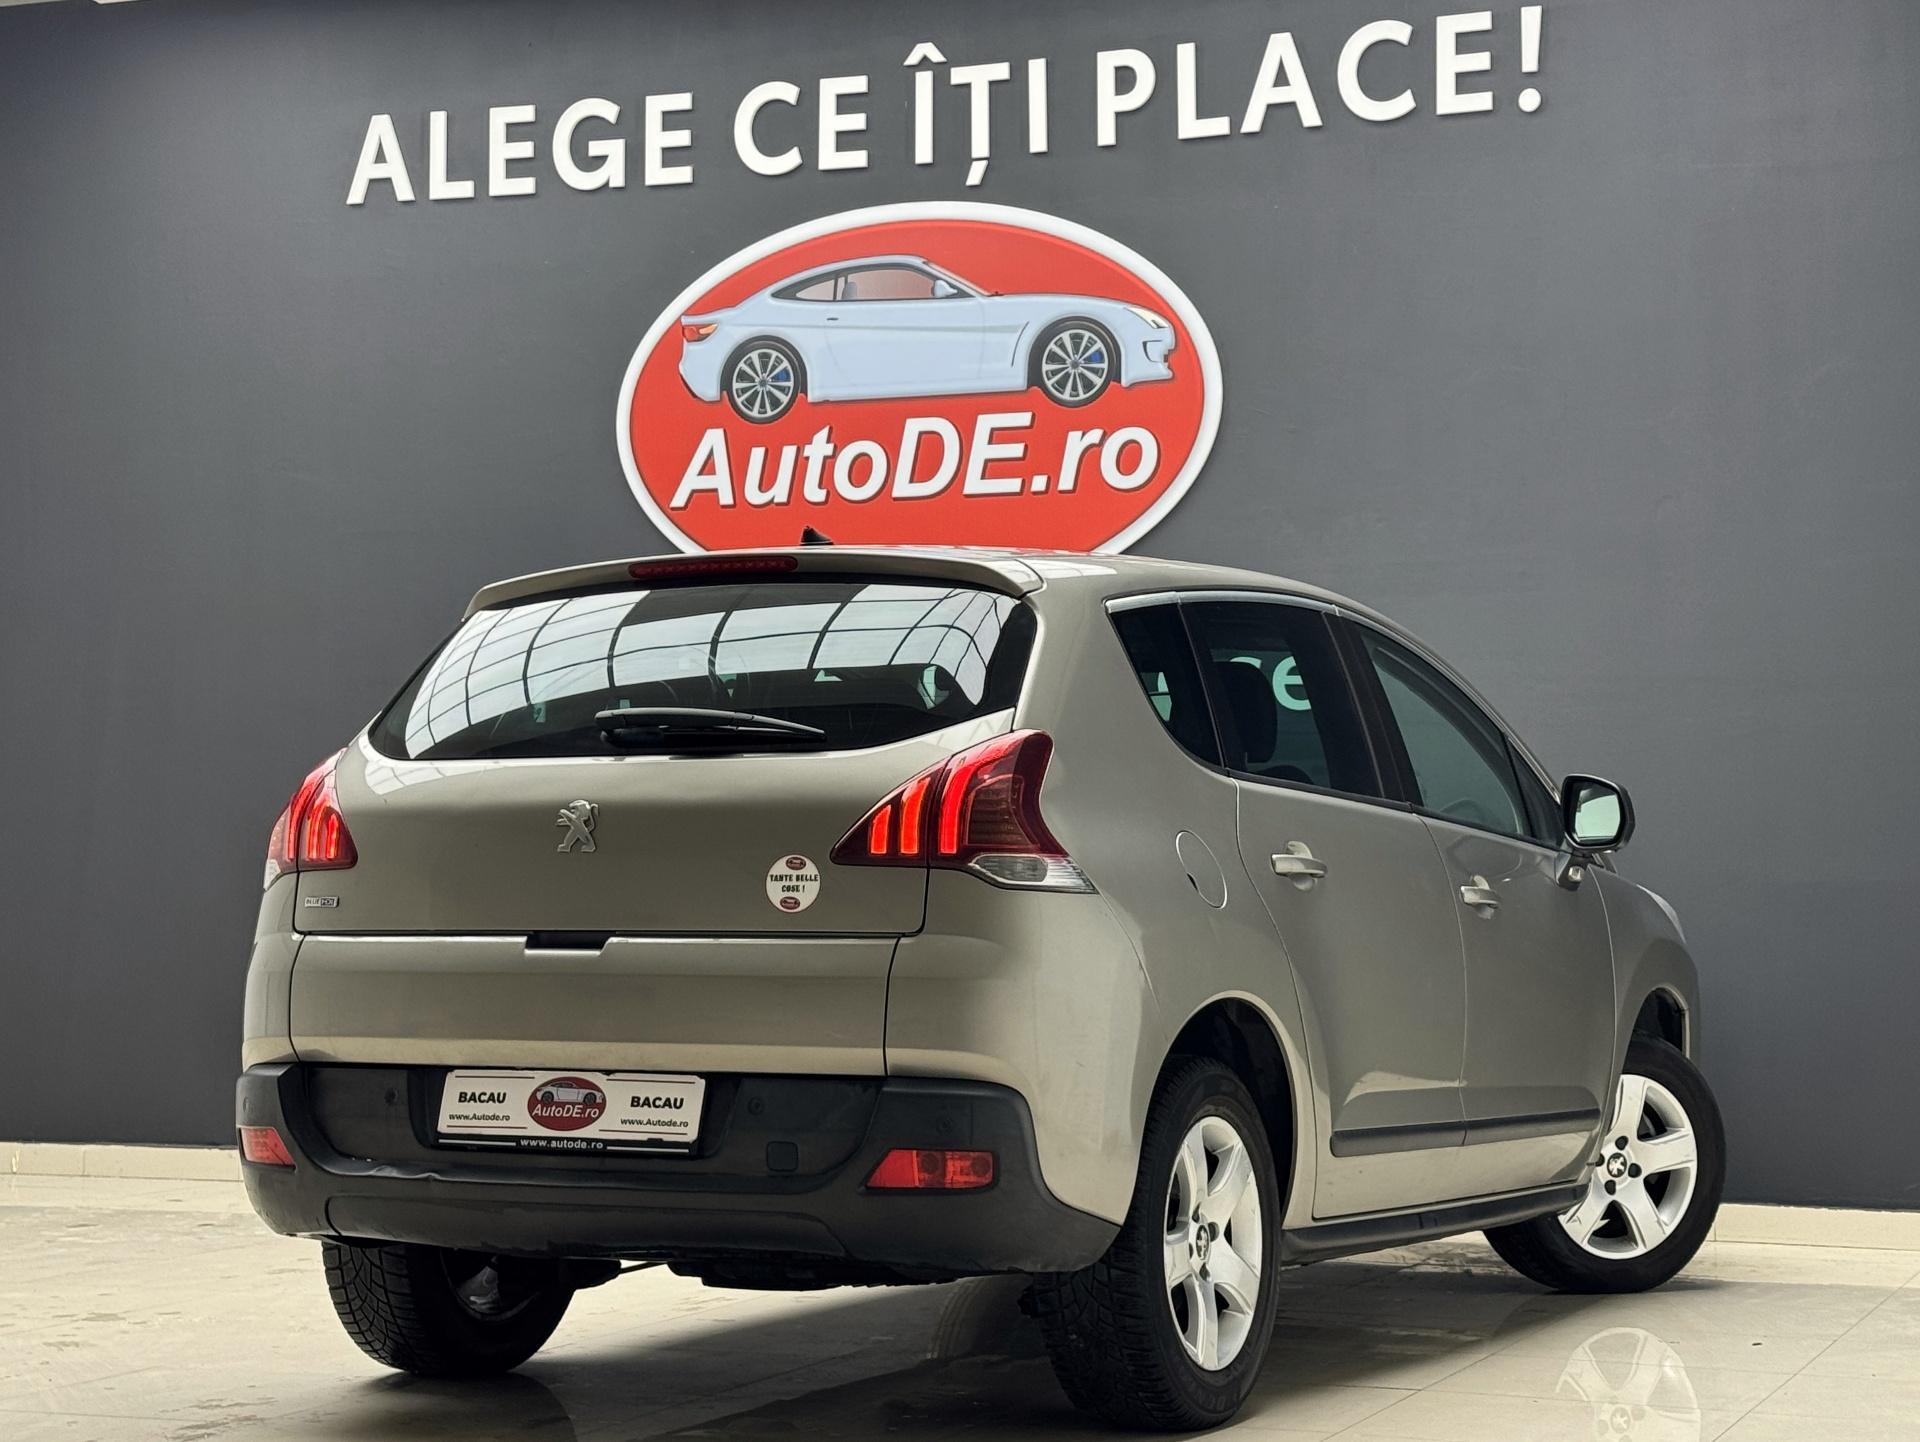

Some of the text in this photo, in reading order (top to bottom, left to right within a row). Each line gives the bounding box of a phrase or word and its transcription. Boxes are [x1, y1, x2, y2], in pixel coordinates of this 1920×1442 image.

[346, 92, 694, 205] ALEGE
[733, 75, 869, 176] CE
[1096, 5, 1543, 148] PLACE!
[669, 411, 1158, 509] AutoDE.ro
[769, 874, 819, 882] TANTE BELLE
[781, 884, 800, 893] COSE
[458, 1091, 507, 1104] BACAU
[630, 1096, 684, 1110] BACAU
[532, 1103, 600, 1118] AutoDE.ro
[448, 1112, 511, 1122] www.Autode.ro
[620, 1118, 689, 1129] www.Autode.ro
[520, 1138, 604, 1150] www.autode.ro
